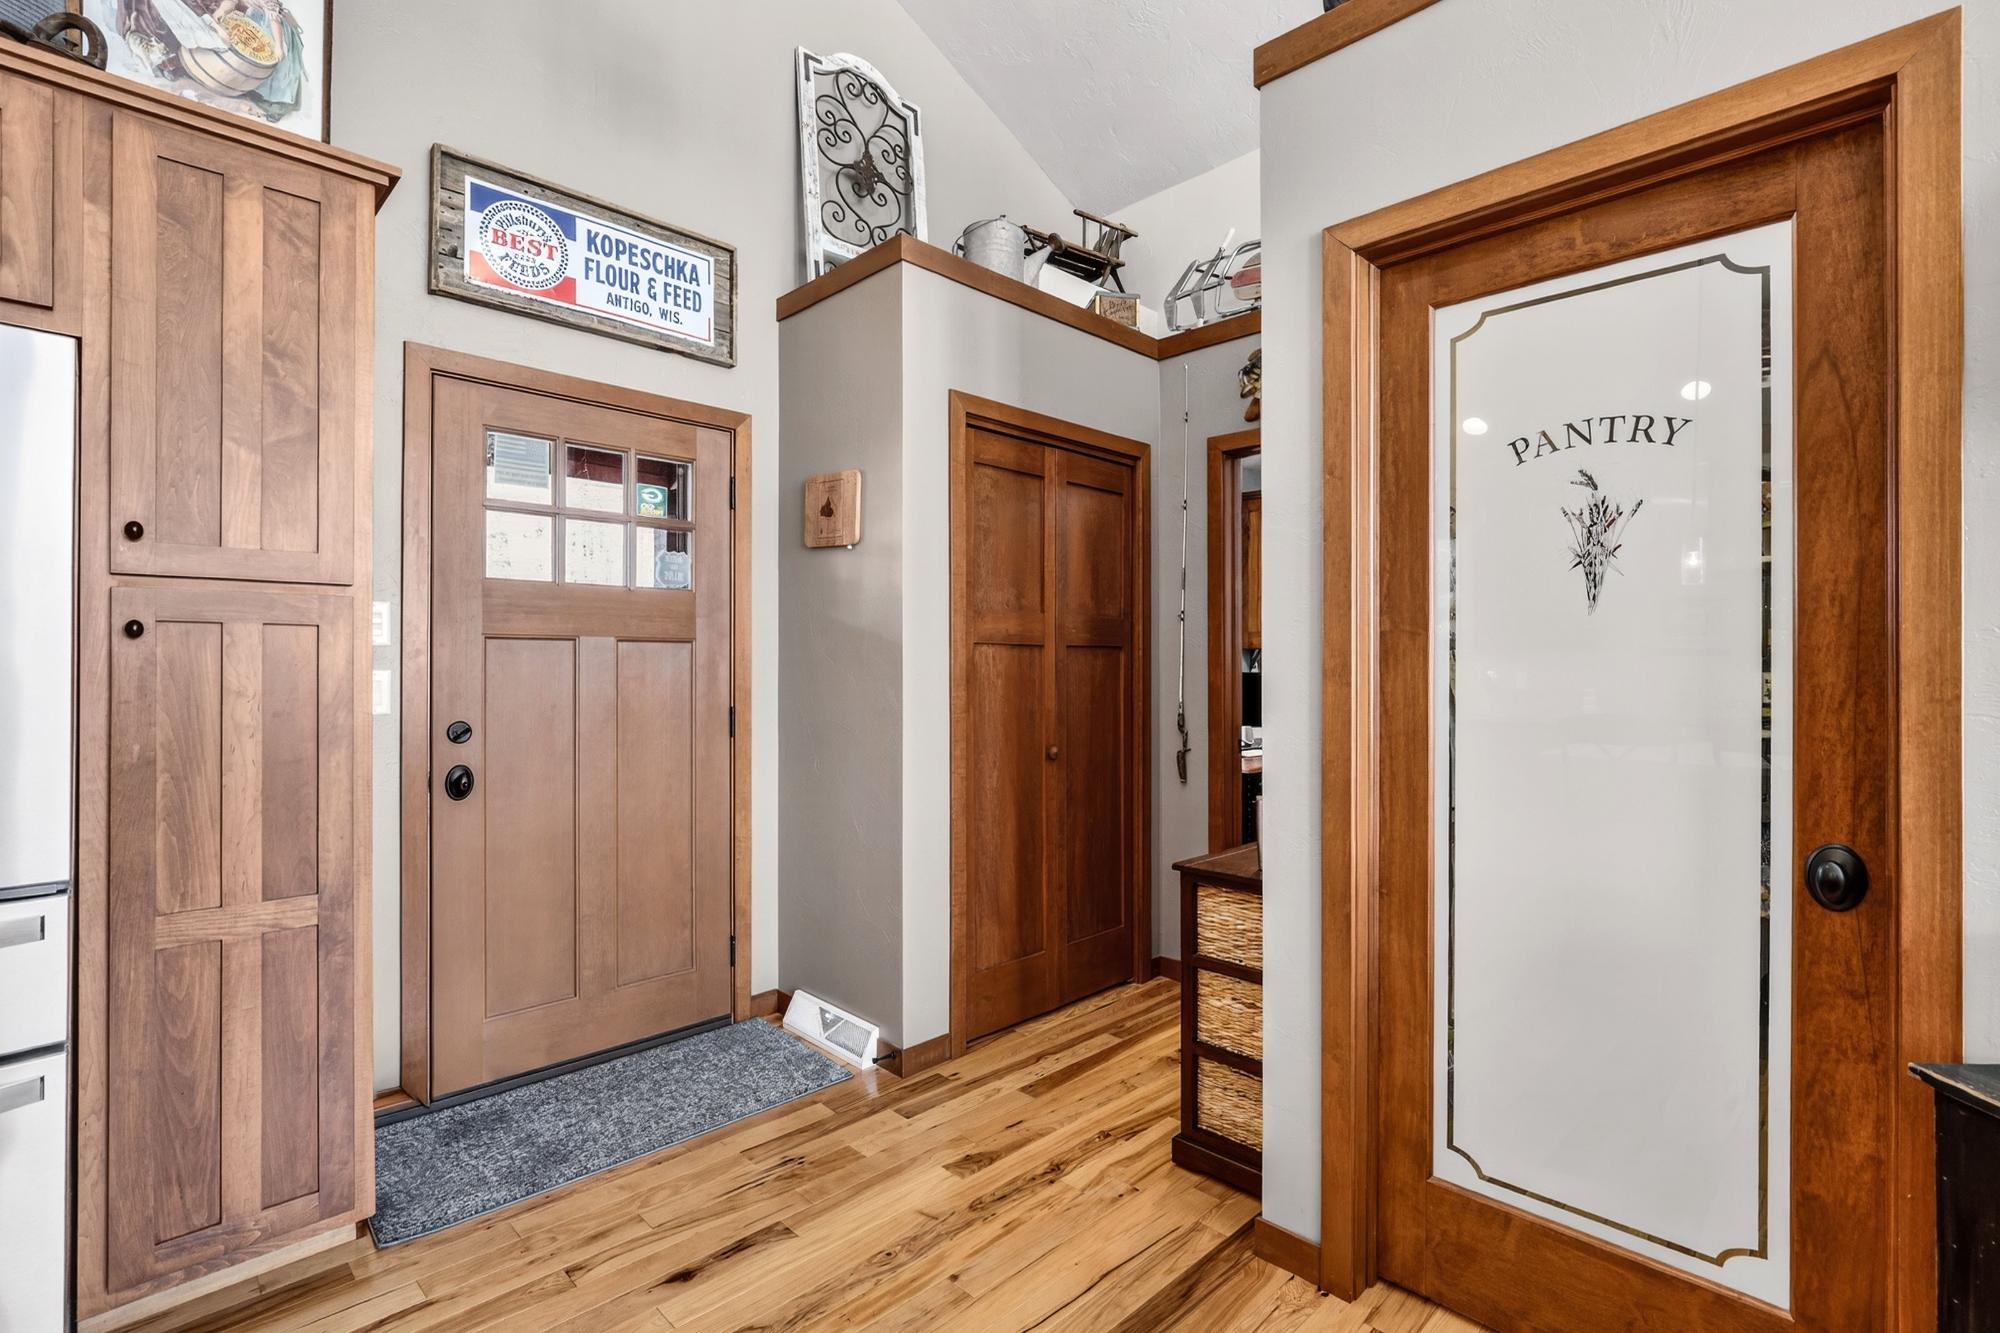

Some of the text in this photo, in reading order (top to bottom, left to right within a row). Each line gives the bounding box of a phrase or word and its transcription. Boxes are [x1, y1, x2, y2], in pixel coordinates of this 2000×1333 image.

[491, 227, 558, 261] BEST
[587, 229, 700, 287] KOPESCHKA
[585, 257, 701, 313] FLOUR & FEED
[606, 292, 683, 325] ANTIGO, WIS.
[1507, 414, 1693, 467] PANTRY
